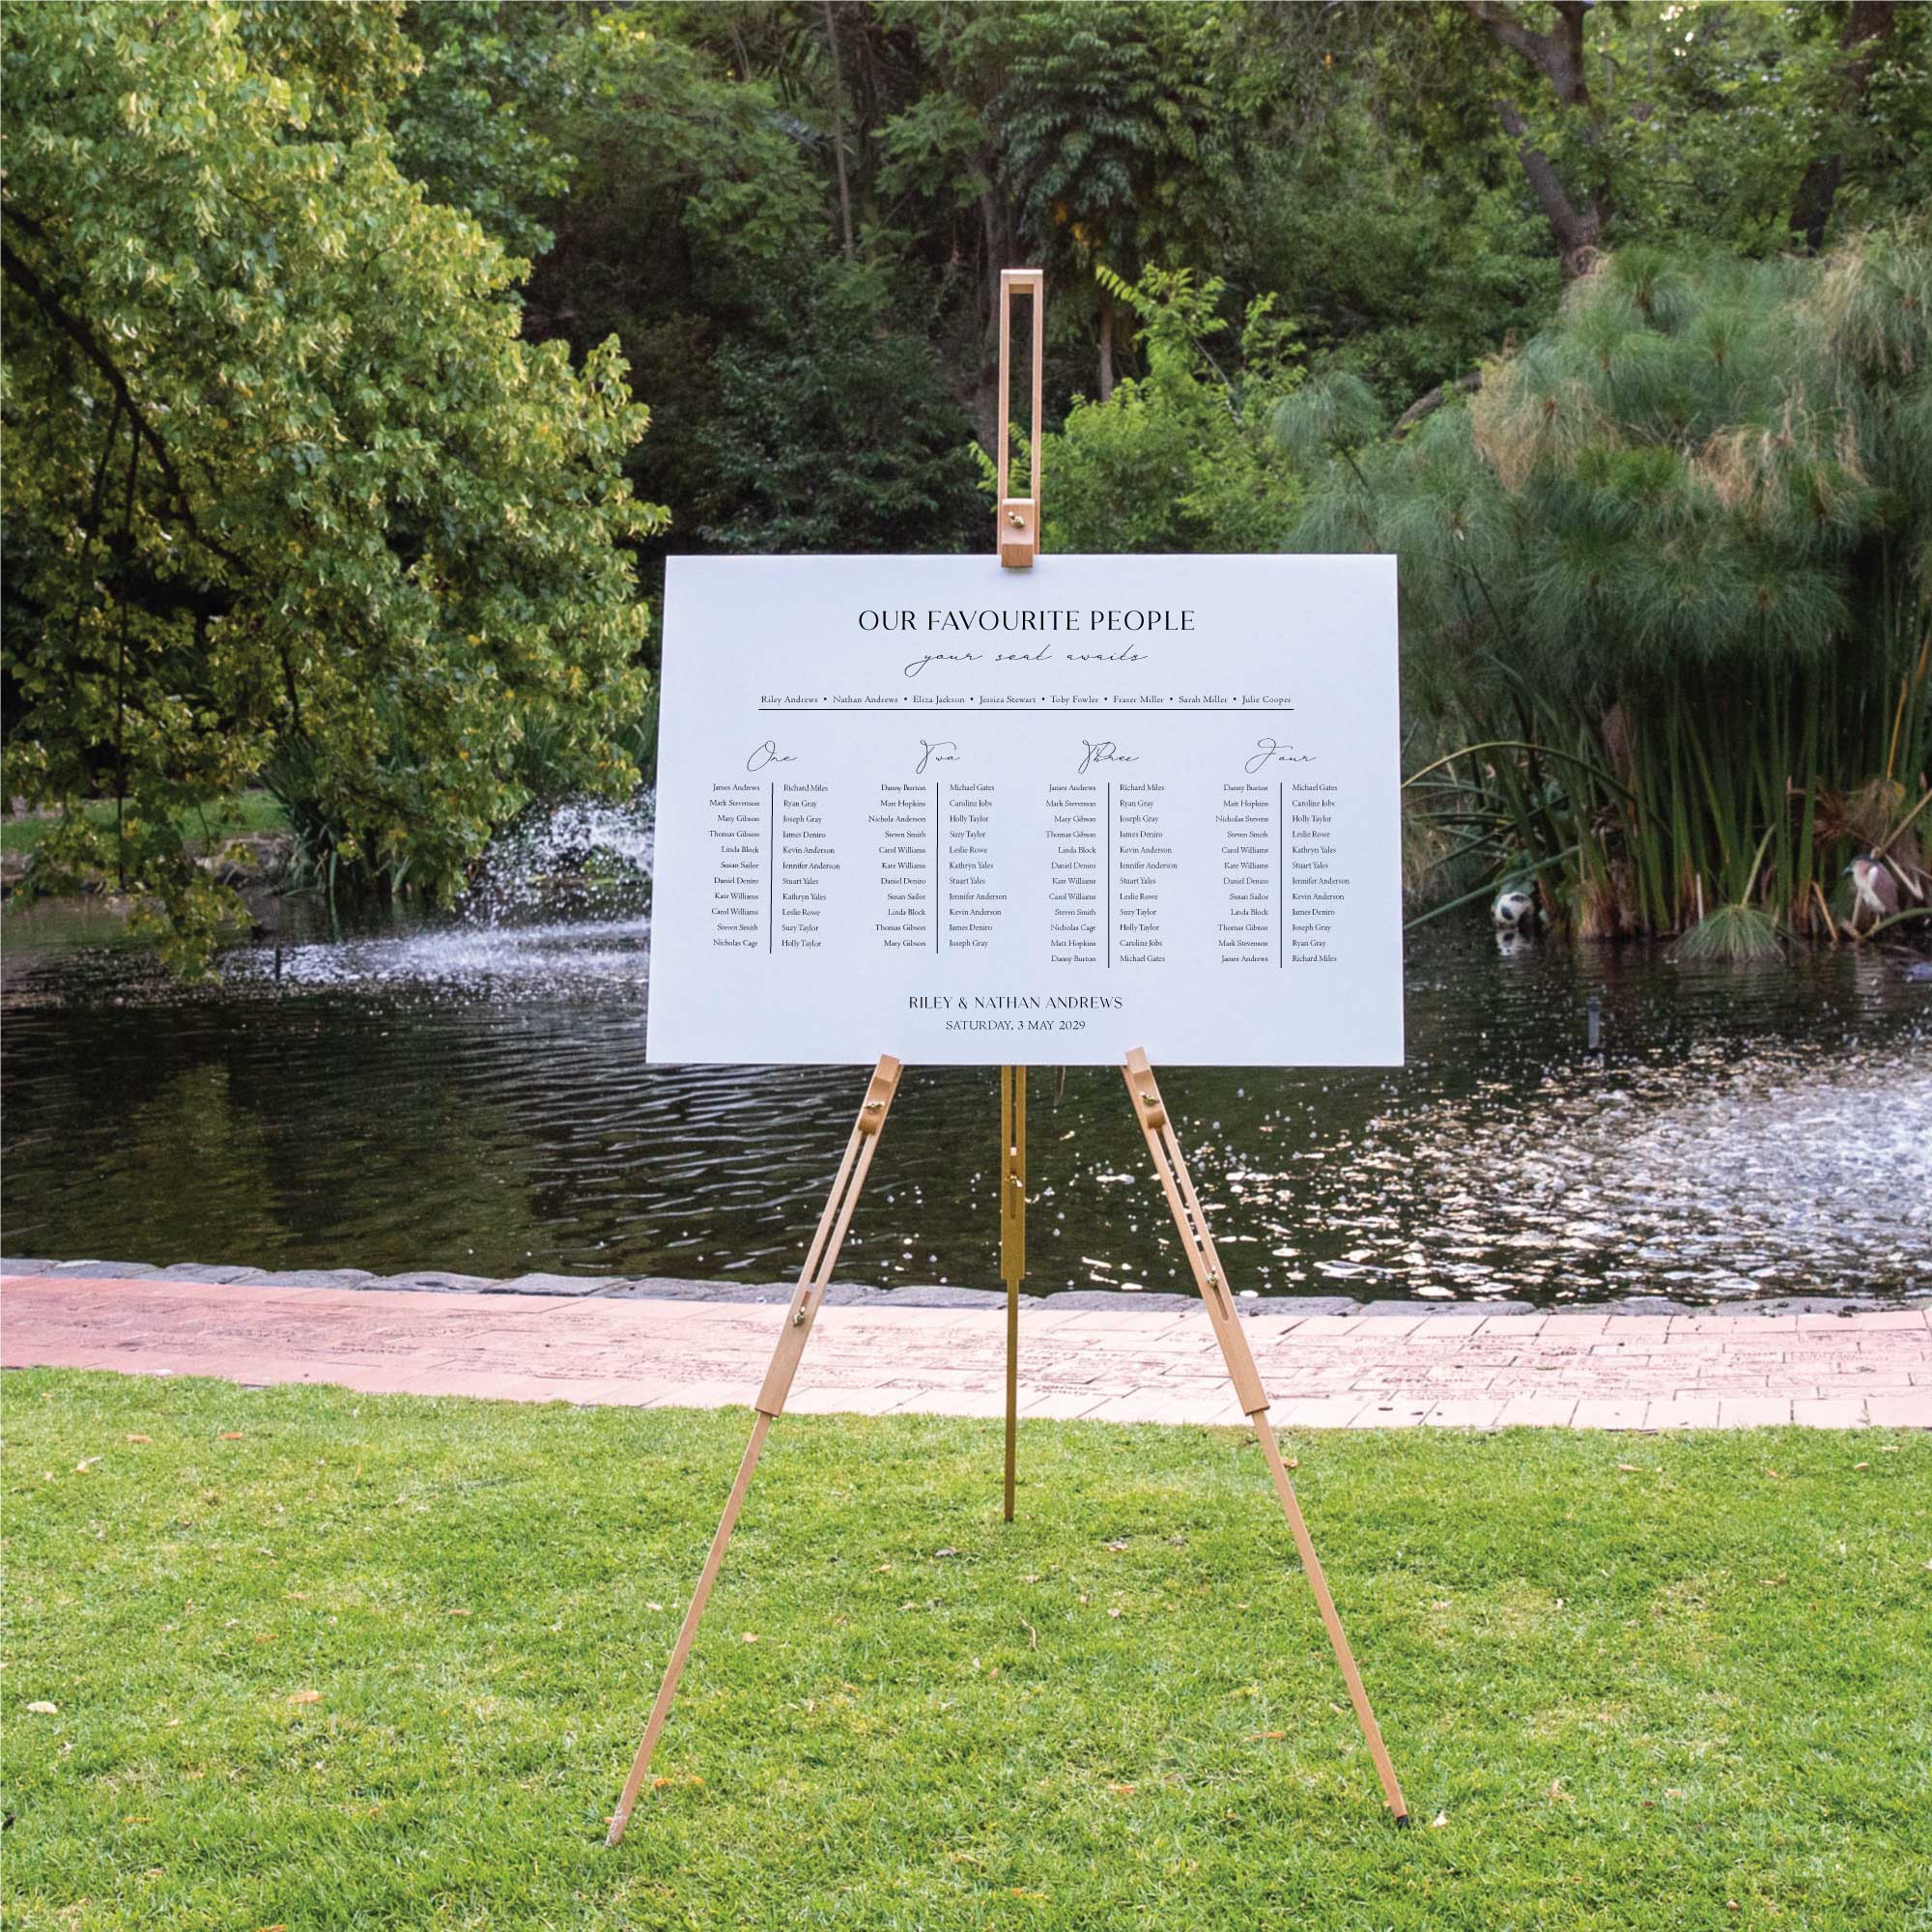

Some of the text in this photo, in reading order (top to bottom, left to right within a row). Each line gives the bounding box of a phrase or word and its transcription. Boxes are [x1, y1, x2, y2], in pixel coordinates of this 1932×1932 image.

[858, 610, 1195, 632] OUR FAVOURITE PEOPLE
[904, 644, 1148, 678] your seat awaits
[760, 695, 1292, 706] Riley Andrews Nathan Andrews Eliza Jackson Jessica Stewart Toby Fowler Fraser Miller Sarah Miller Julie Cooper
[746, 740, 798, 772] One
[916, 739, 961, 775] Two
[1078, 739, 1140, 775] Three
[1244, 737, 1318, 775] Four
[782, 799, 817, 809] Ryan Gray
[979, 799, 993, 809] Jobs
[1120, 799, 1154, 809] Ryan Gray
[1321, 799, 1336, 809] Jobs
[717, 814, 735, 824] Mary
[782, 814, 823, 824] Joseph Gray
[950, 814, 990, 824] Holly Taylor
[1120, 814, 1159, 824] Joseph Gray
[1292, 814, 1332, 824] Holly Taylor
[782, 830, 802, 838] James
[949, 830, 986, 839] Suzy Taylor
[1292, 845, 1320, 855] Kathryn
[782, 861, 809, 869] Jennifer
[949, 861, 977, 870] Kathryn
[1120, 861, 1146, 869] Jennifer
[1292, 876, 1318, 885] Jennifer
[781, 893, 810, 902] Kathryn
[949, 893, 976, 901] Jennifer
[1120, 908, 1157, 918] Suzy Taylor
[1292, 908, 1312, 917] James
[781, 923, 819, 933] Suzy Taylor
[949, 923, 969, 932] James
[1080, 923, 1096, 933] Cage
[1120, 923, 1160, 933] Holly Taylor
[1292, 923, 1332, 933] Joseph Gray
[742, 939, 758, 949] Cage
[781, 939, 822, 949] Holly Taylor
[883, 939, 901, 949] Mary
[949, 939, 989, 949] Joseph Gray
[1149, 939, 1163, 949] Jobs
[1292, 939, 1326, 949] Ryan Gray
[909, 996, 1123, 1010] RILEY & NATHAN ANDREWS
[945, 1020, 1086, 1032] SATURDAY, 3 MAY 2029
